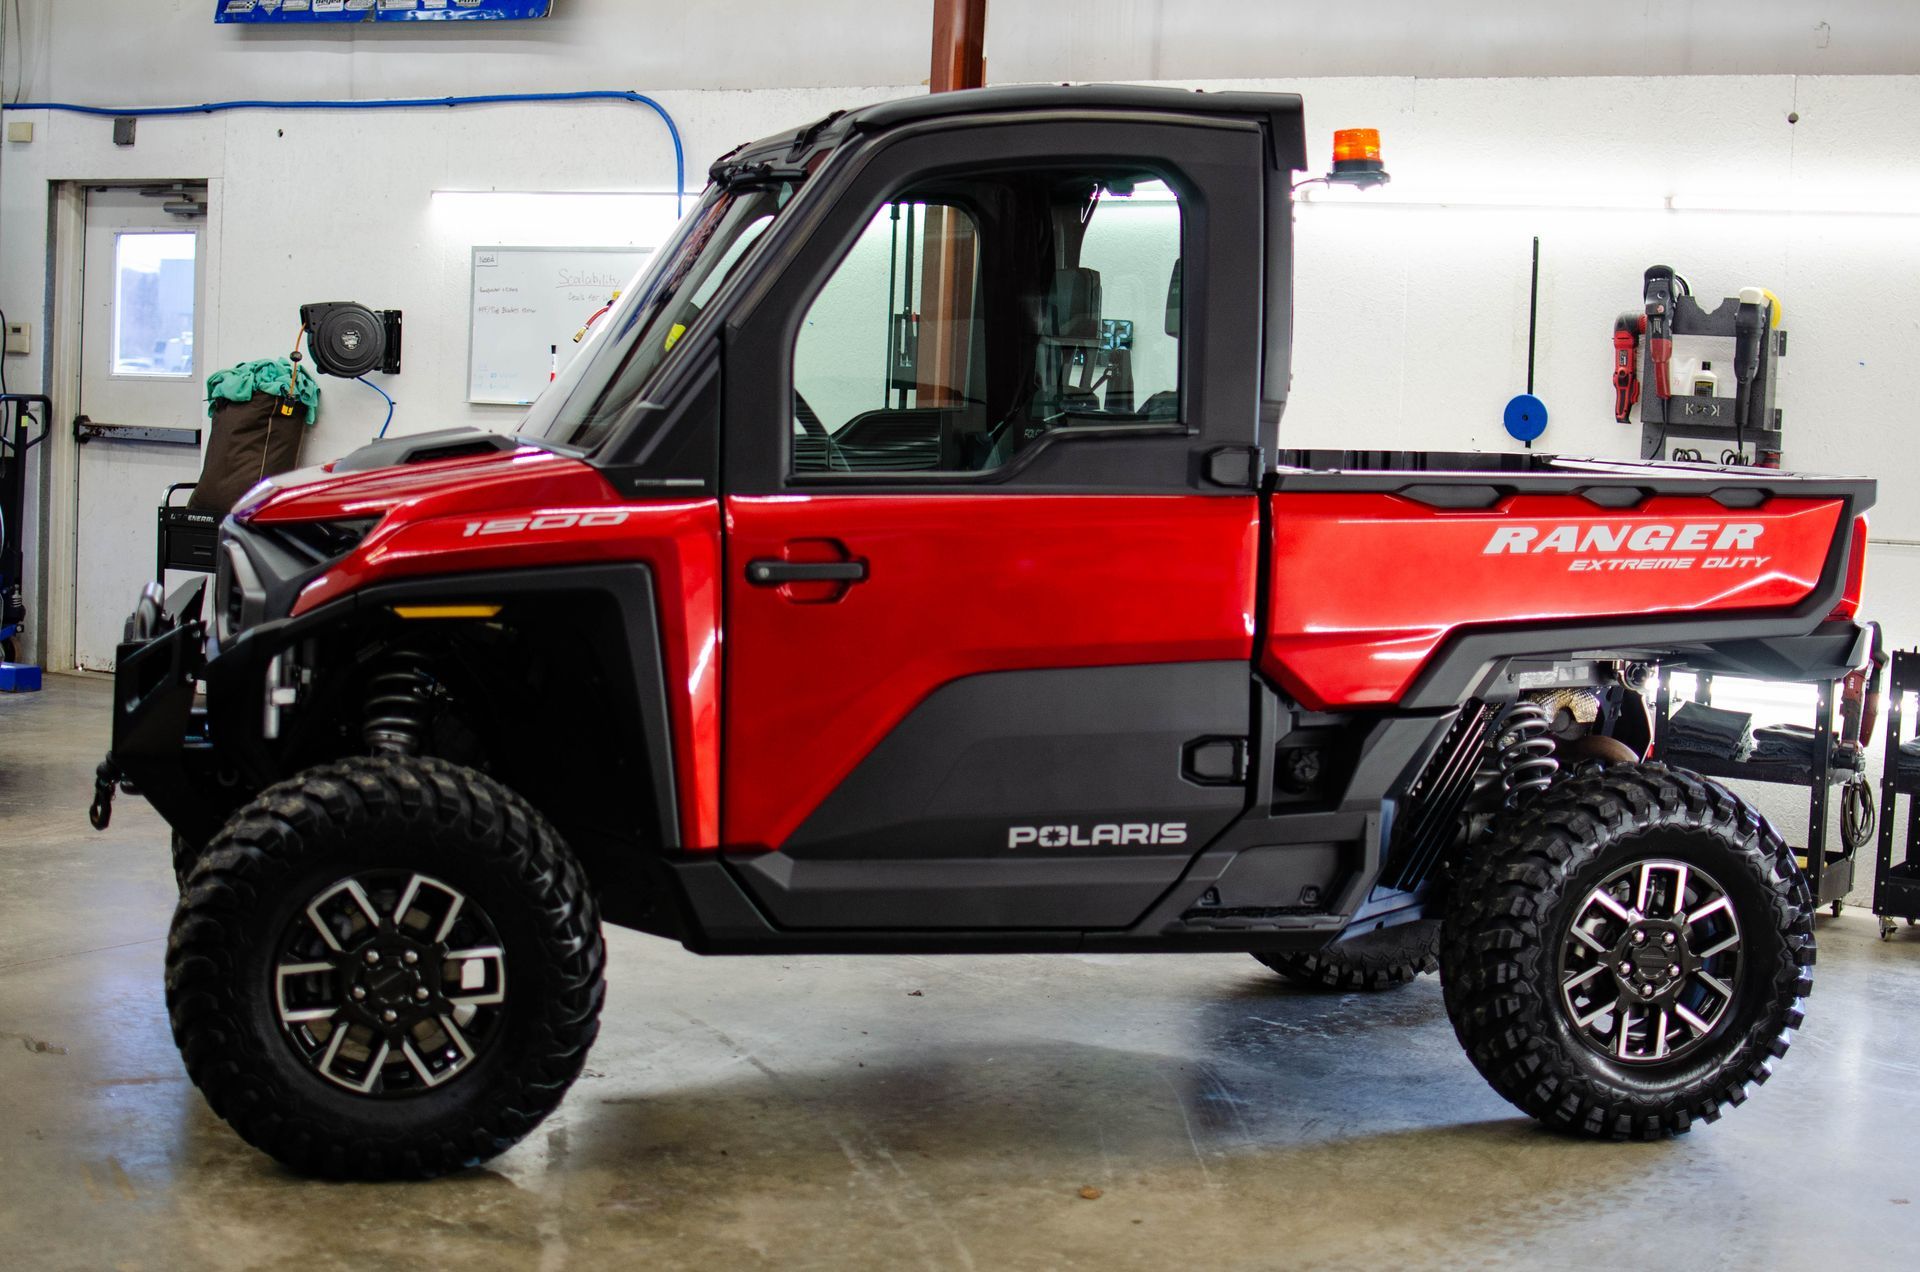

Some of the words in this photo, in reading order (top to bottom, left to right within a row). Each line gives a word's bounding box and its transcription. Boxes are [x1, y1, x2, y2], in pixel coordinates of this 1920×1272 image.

[558, 268, 621, 289] Scalability
[463, 512, 629, 537] 1500
[1482, 523, 1764, 554] RANGER
[1567, 558, 1696, 571] EXTREME
[1701, 556, 1771, 569] DUTY
[1008, 822, 1188, 849] POLARIS
